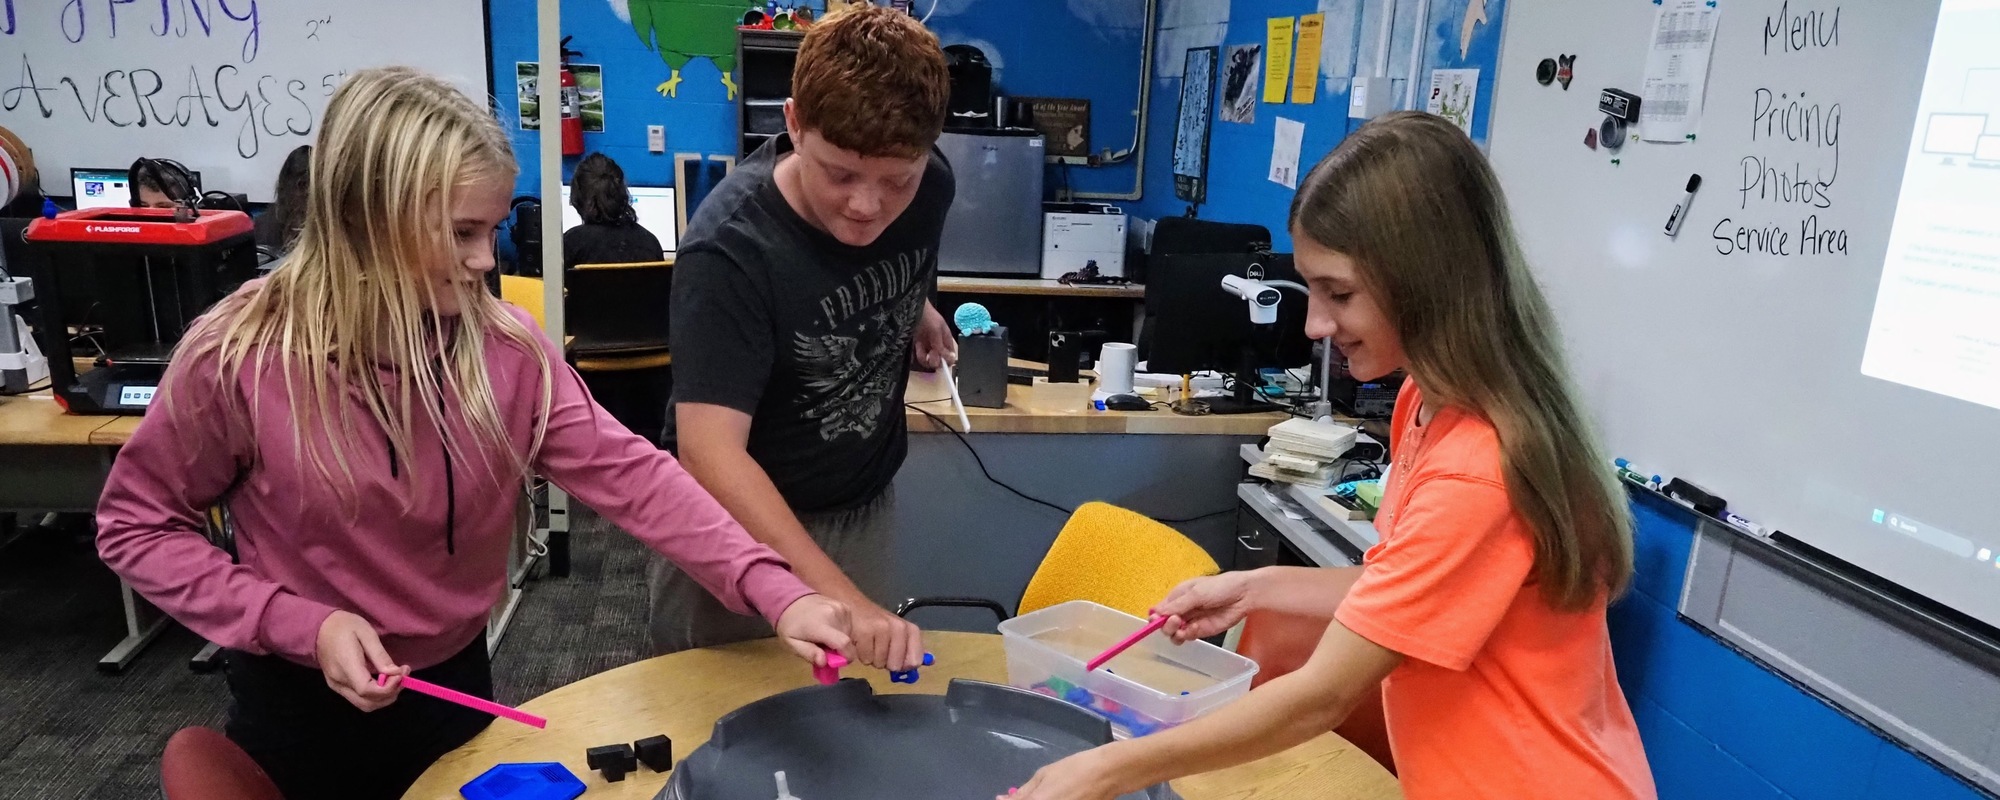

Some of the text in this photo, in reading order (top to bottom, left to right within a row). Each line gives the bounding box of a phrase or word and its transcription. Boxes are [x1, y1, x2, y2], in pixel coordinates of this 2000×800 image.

[305, 15, 332, 41] 2nd
[1764, 0, 1840, 56] Menu
[2, 52, 314, 159] AVERAGES
[1751, 88, 1841, 187] Pricing
[1739, 155, 1831, 209] Photos
[1713, 214, 1847, 256] Service Area
